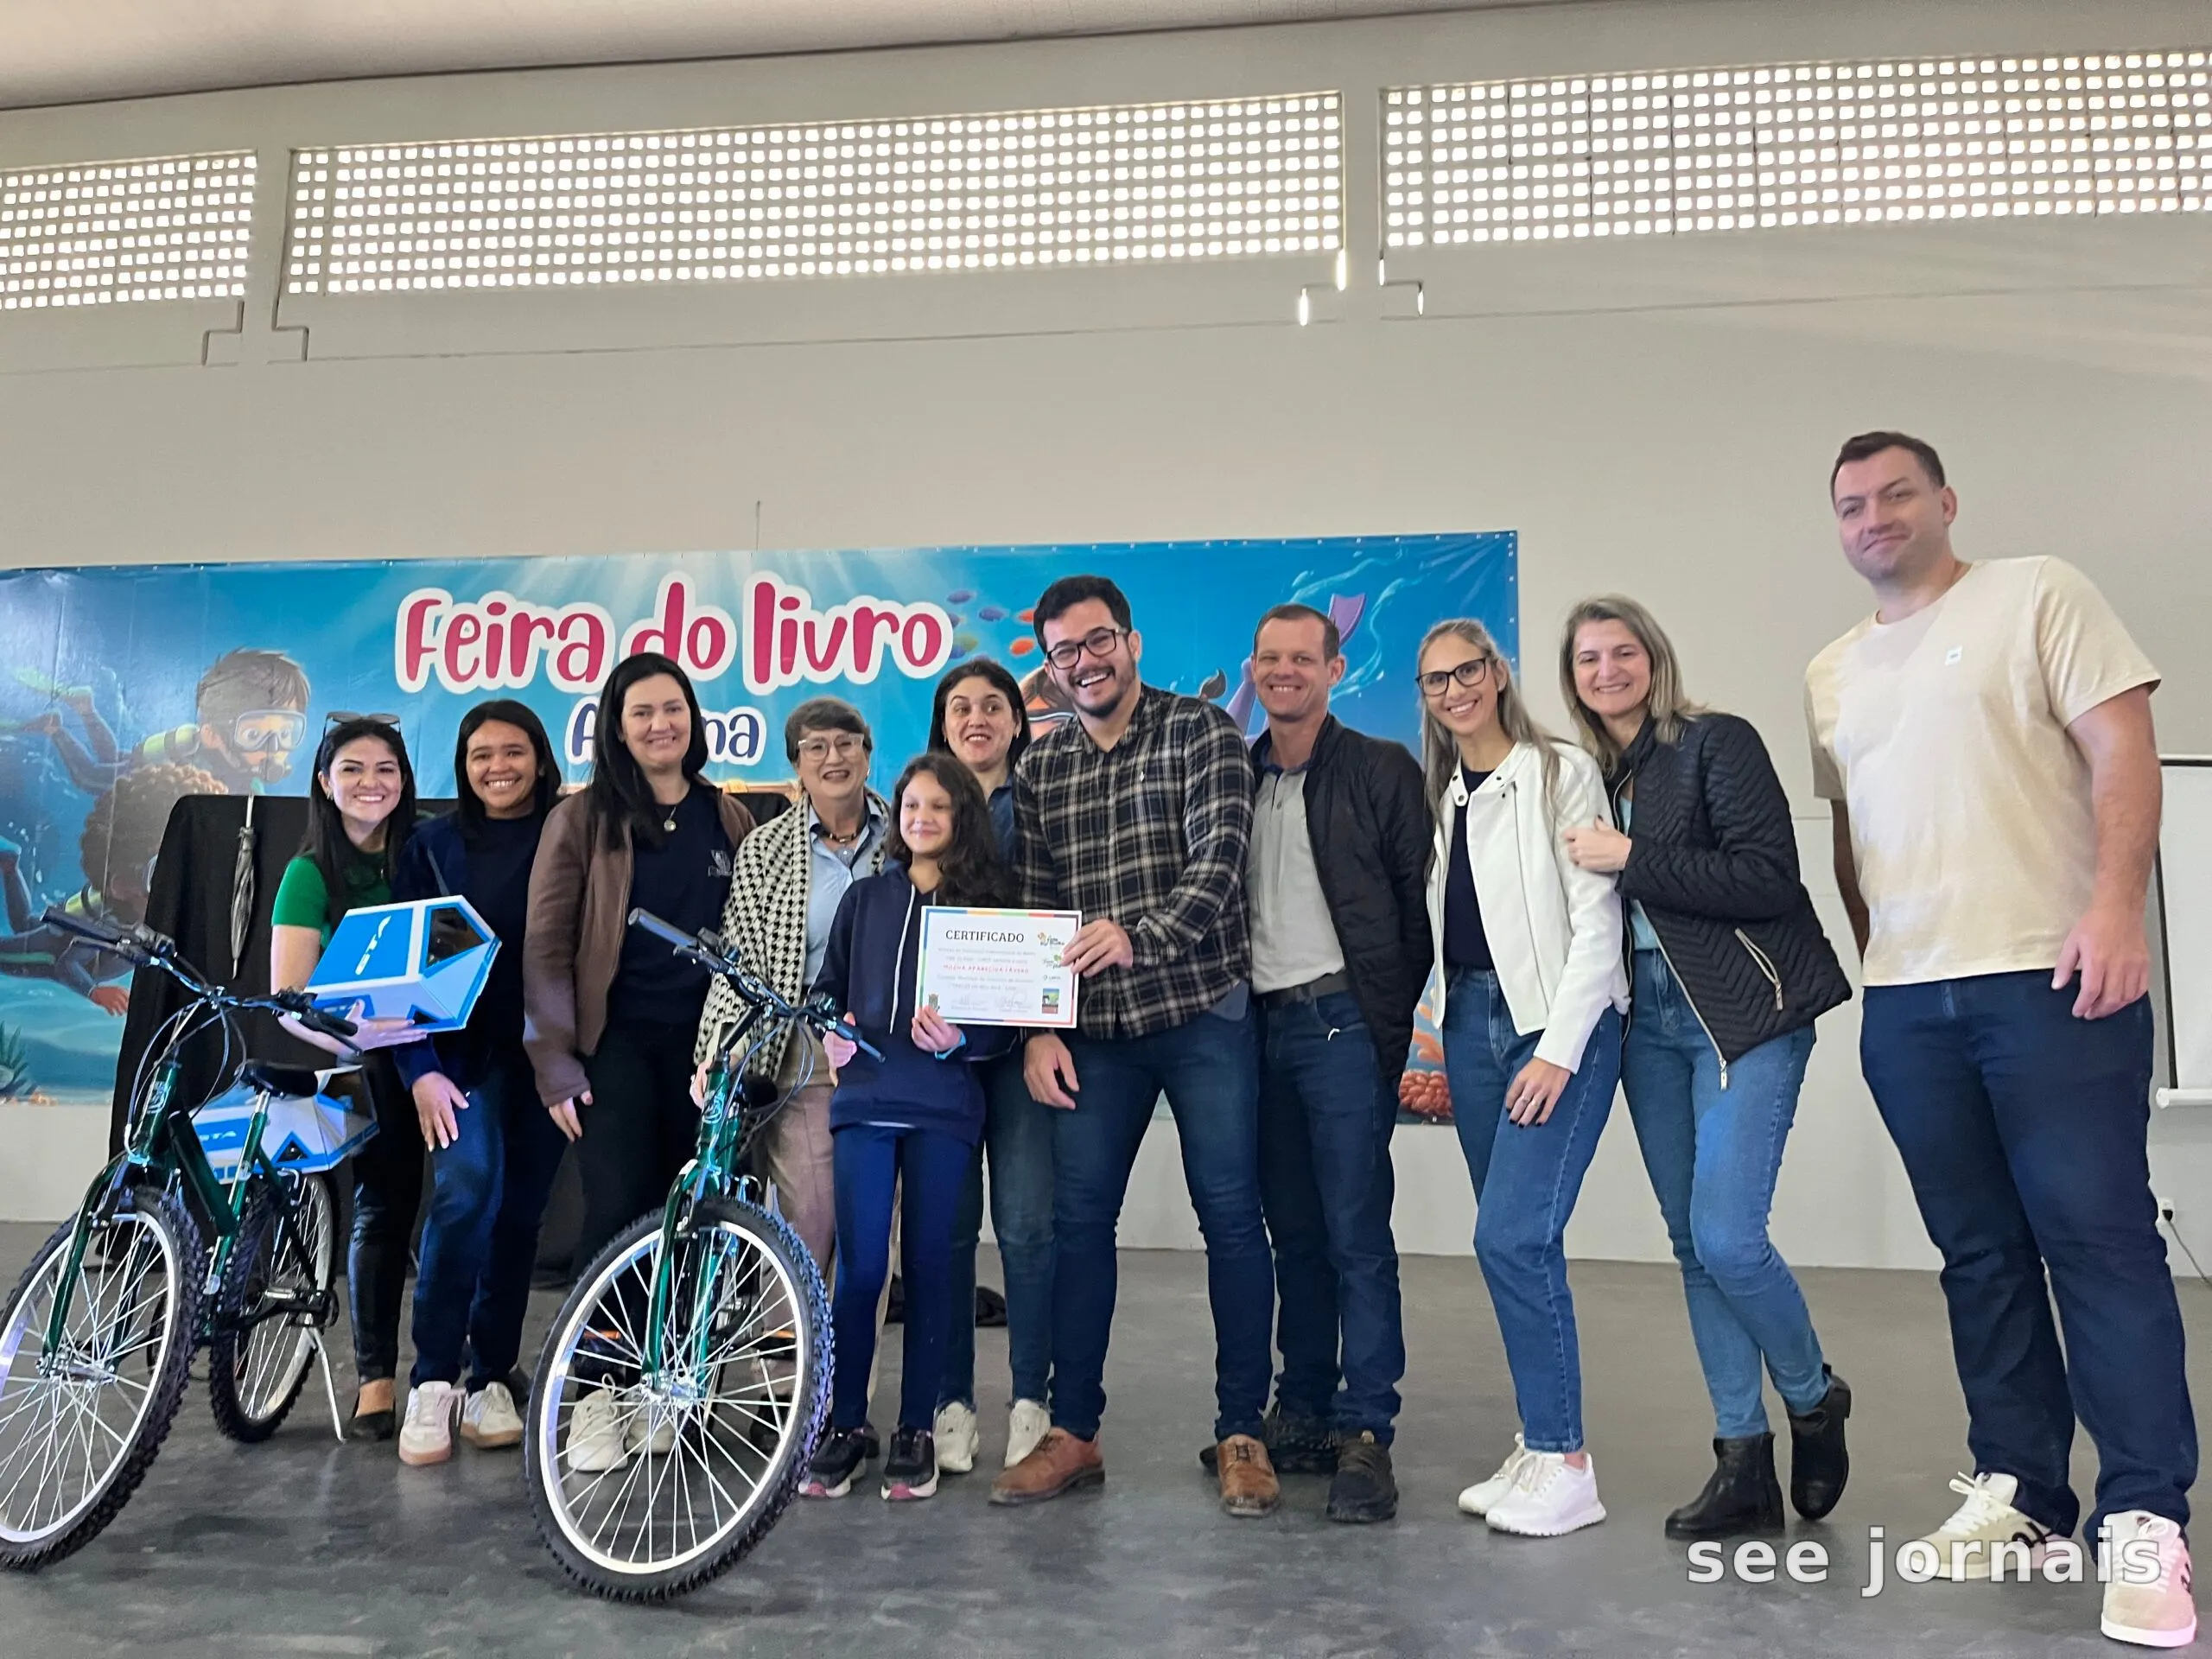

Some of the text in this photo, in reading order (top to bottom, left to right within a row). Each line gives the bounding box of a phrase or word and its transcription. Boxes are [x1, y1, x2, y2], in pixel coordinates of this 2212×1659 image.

[405, 582, 942, 683] Feira do livro
[945, 930, 1025, 944] CERTIFICADO
